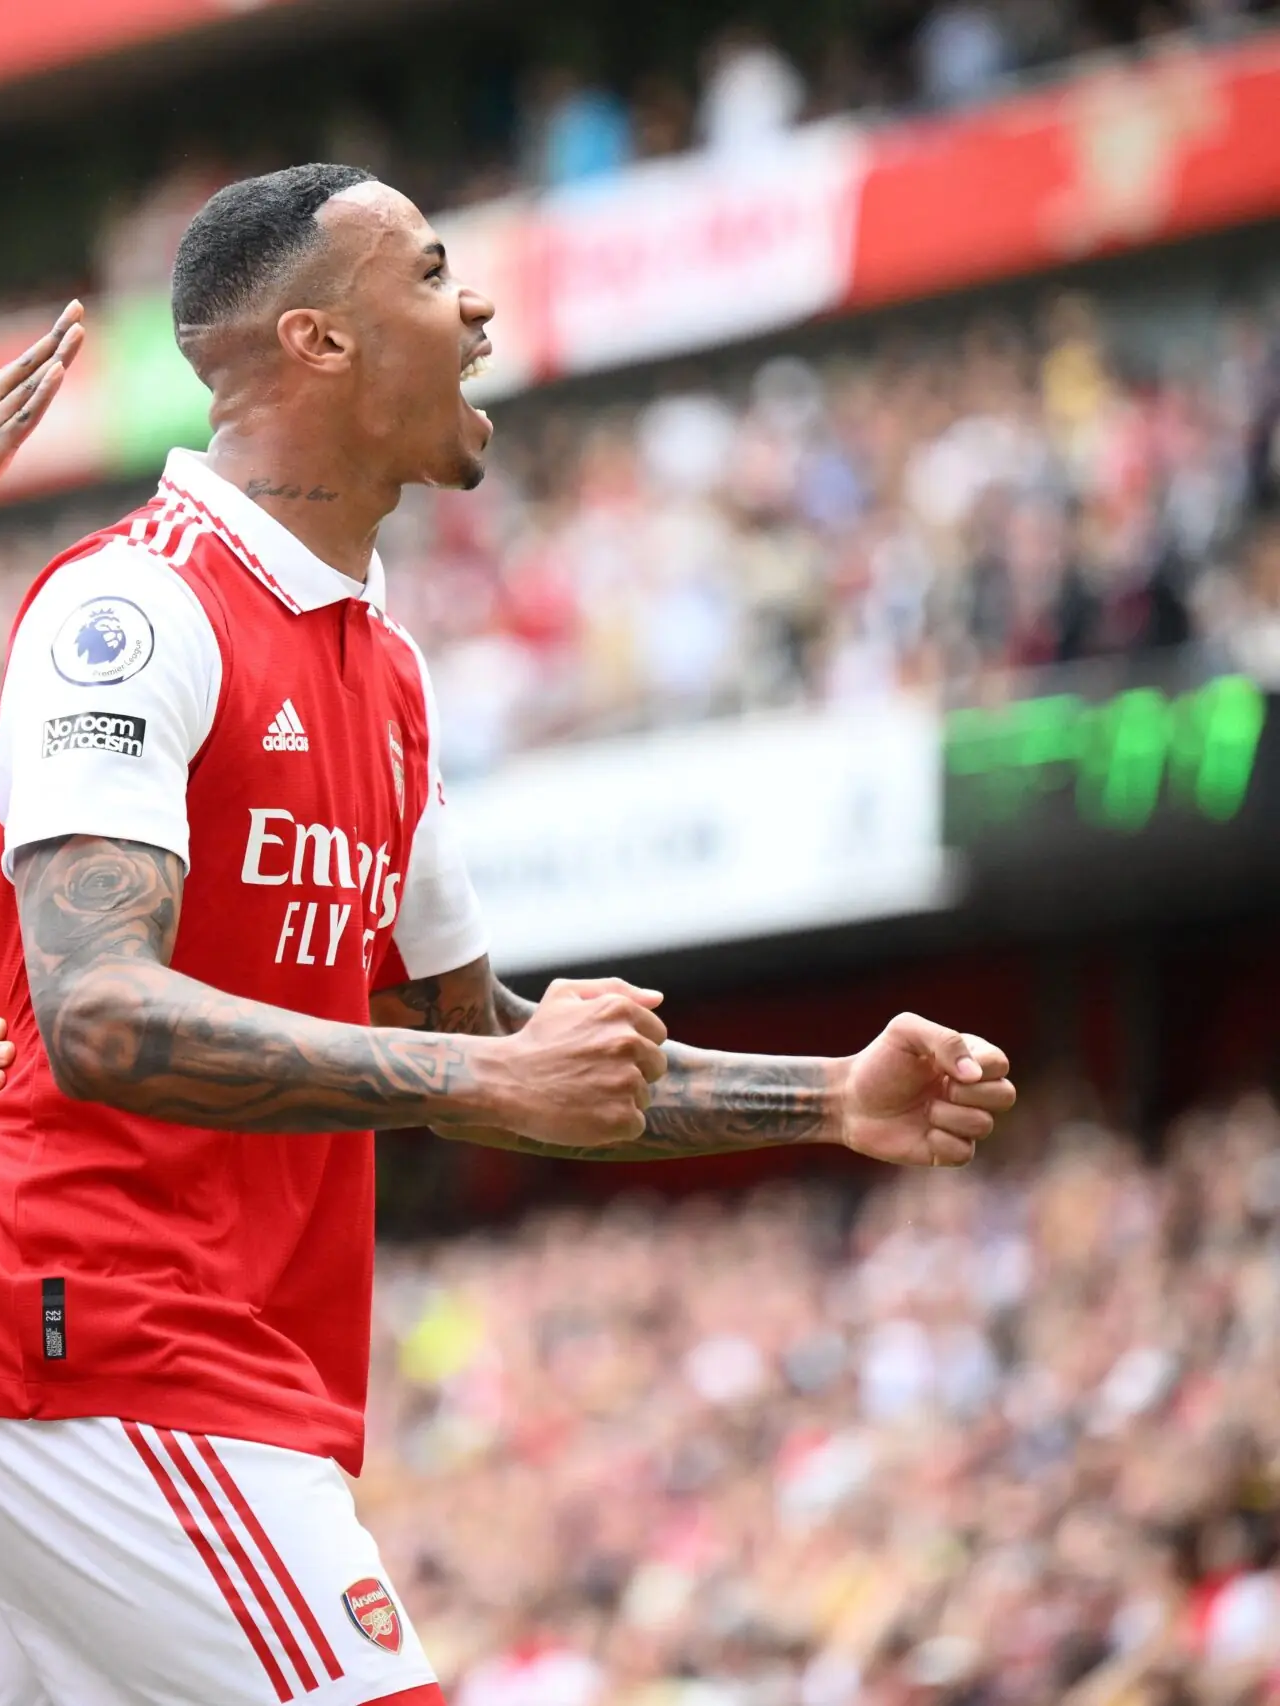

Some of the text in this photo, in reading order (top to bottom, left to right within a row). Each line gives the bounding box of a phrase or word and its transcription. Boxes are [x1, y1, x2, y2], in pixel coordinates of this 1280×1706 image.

[123, 639, 143, 666] League
[42, 715, 135, 740] No room
[69, 732, 143, 757] racism
[262, 732, 310, 752] adidas
[274, 901, 352, 967] FLY
